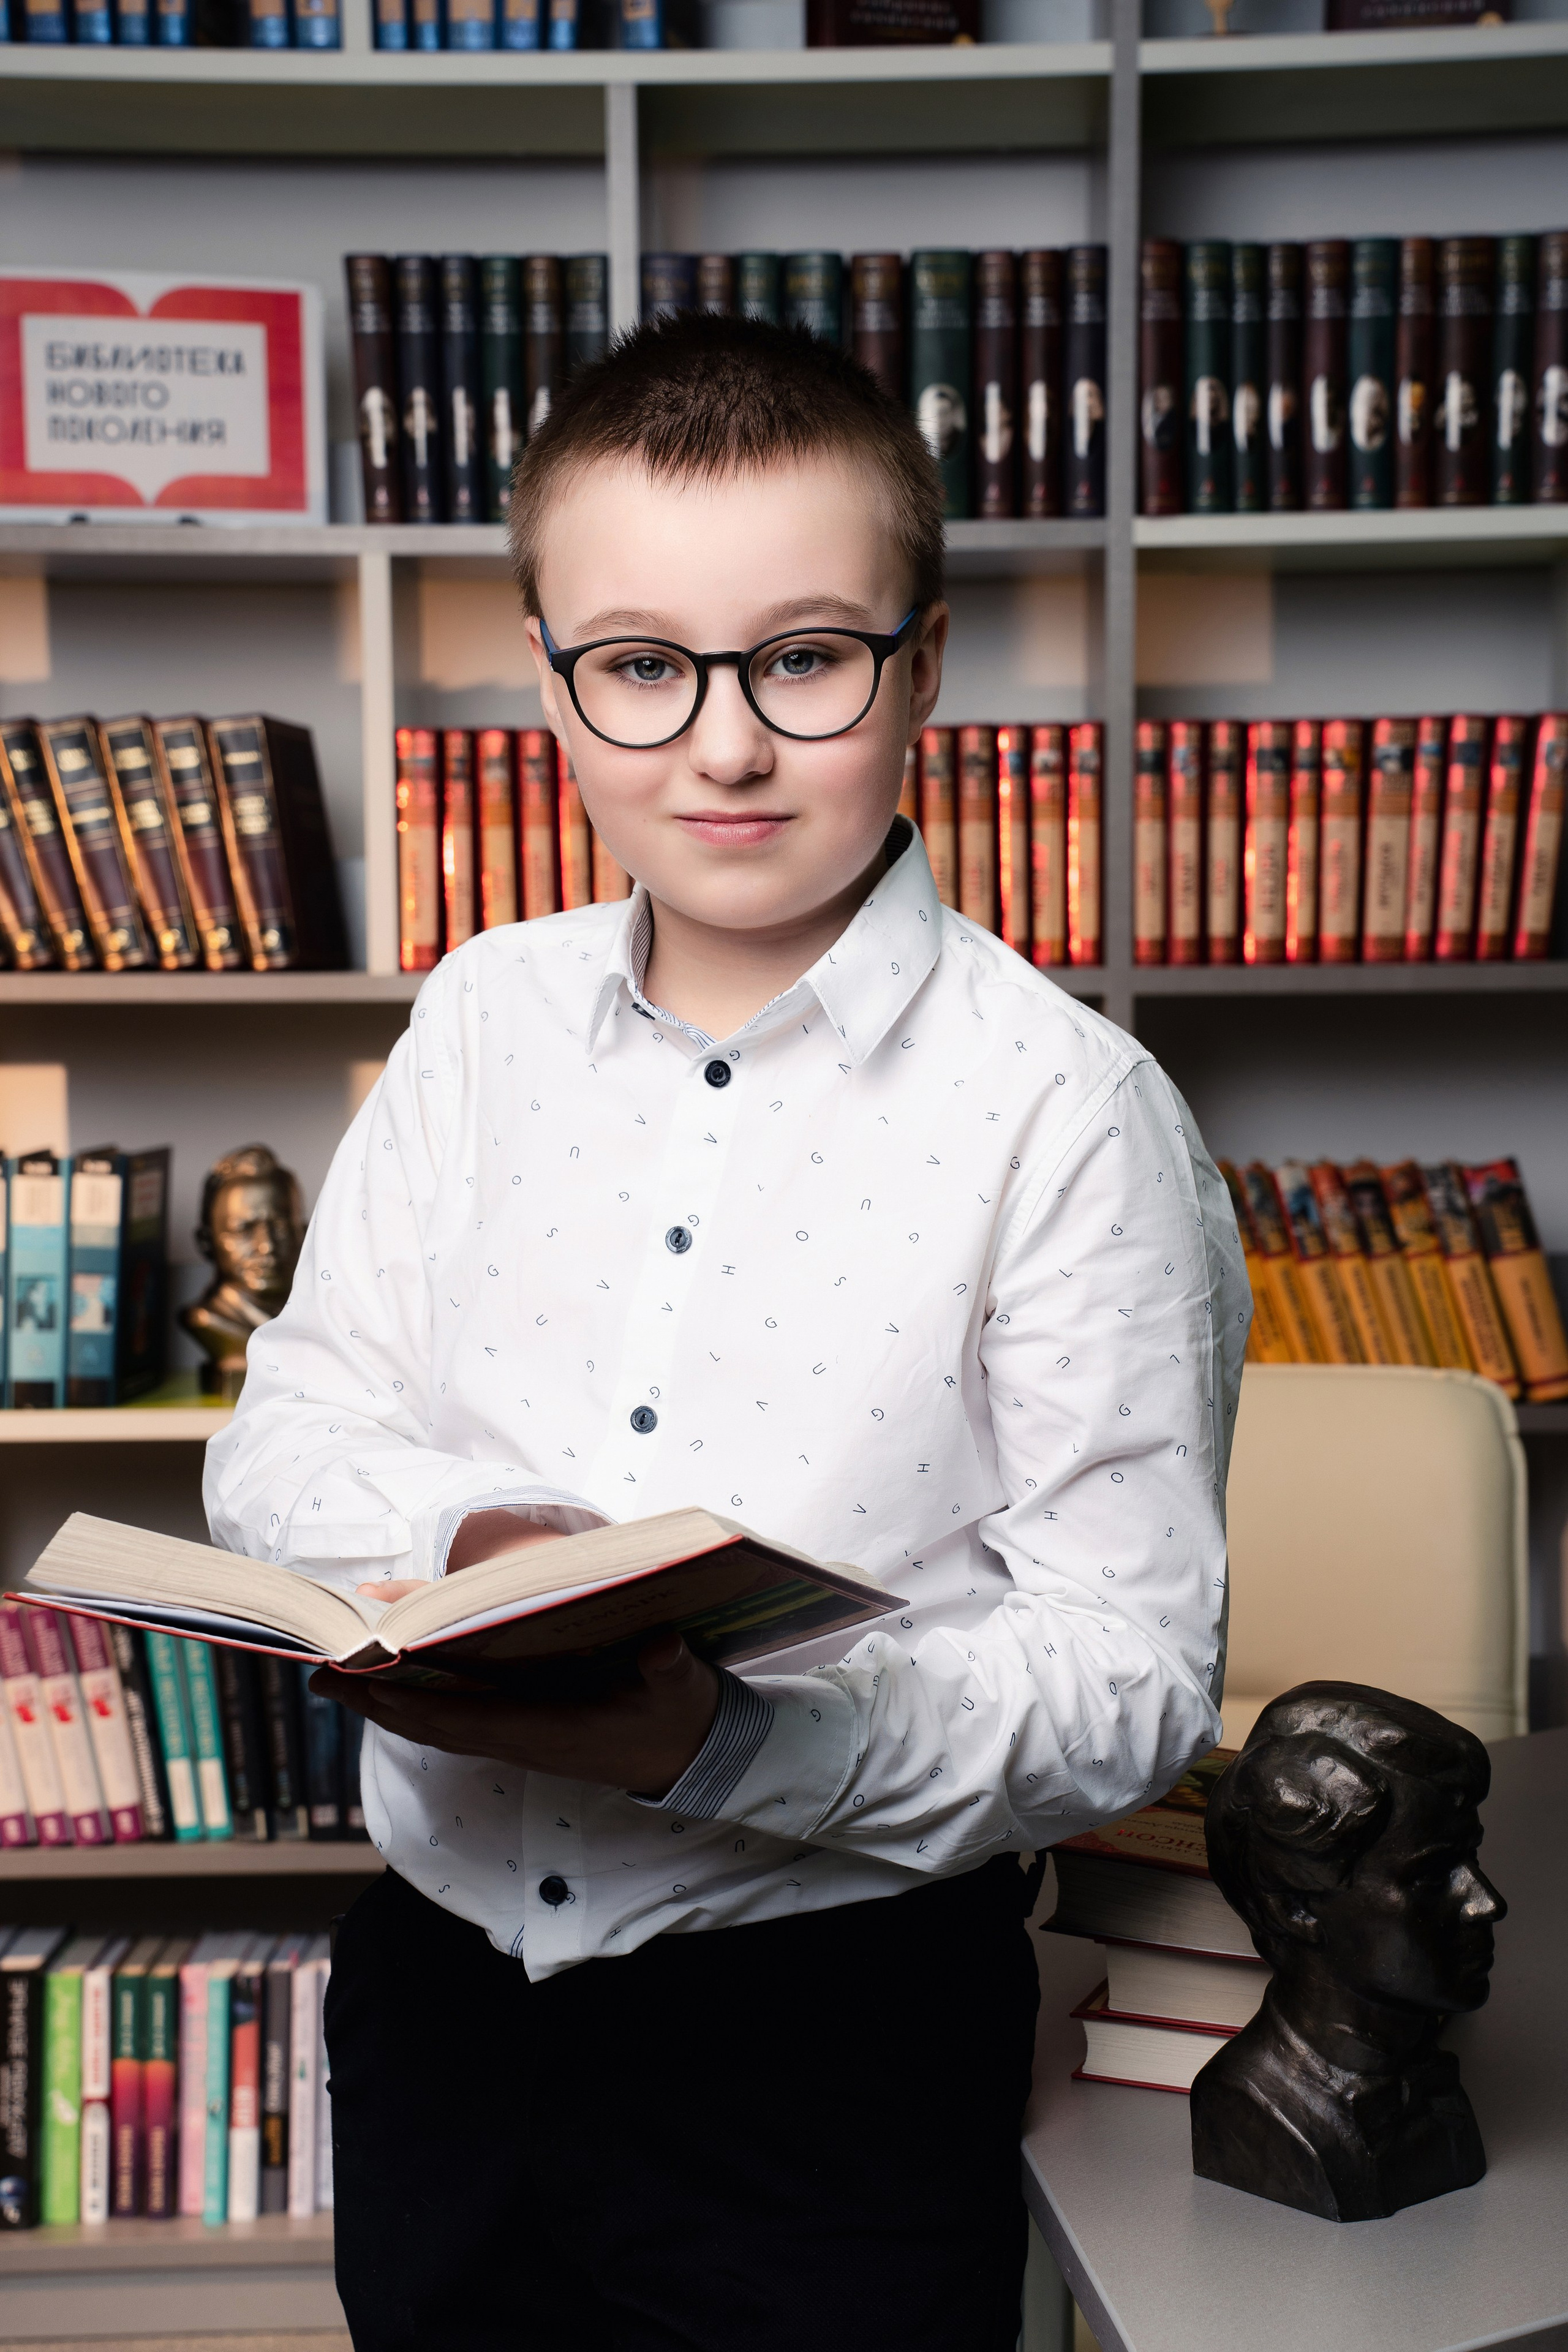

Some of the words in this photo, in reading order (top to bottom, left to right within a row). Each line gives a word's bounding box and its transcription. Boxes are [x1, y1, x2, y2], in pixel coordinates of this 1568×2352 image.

[46, 341, 247, 376] БИБЛИОТЕКА
[46, 378, 170, 411] НОВОГО
[47, 414, 227, 445] ПОКОЛЕНИЯ
[1015, 1041, 1027, 1053] R
[1156, 1172, 1164, 1183] S
[546, 1227, 559, 1238] S
[376, 1268, 385, 1278] S
[834, 1276, 846, 1287] S
[943, 1376, 956, 1389] R
[1166, 1526, 1175, 1538] S
[552, 1588, 679, 1634] РЕМАРК
[438, 1884, 451, 1893] S
